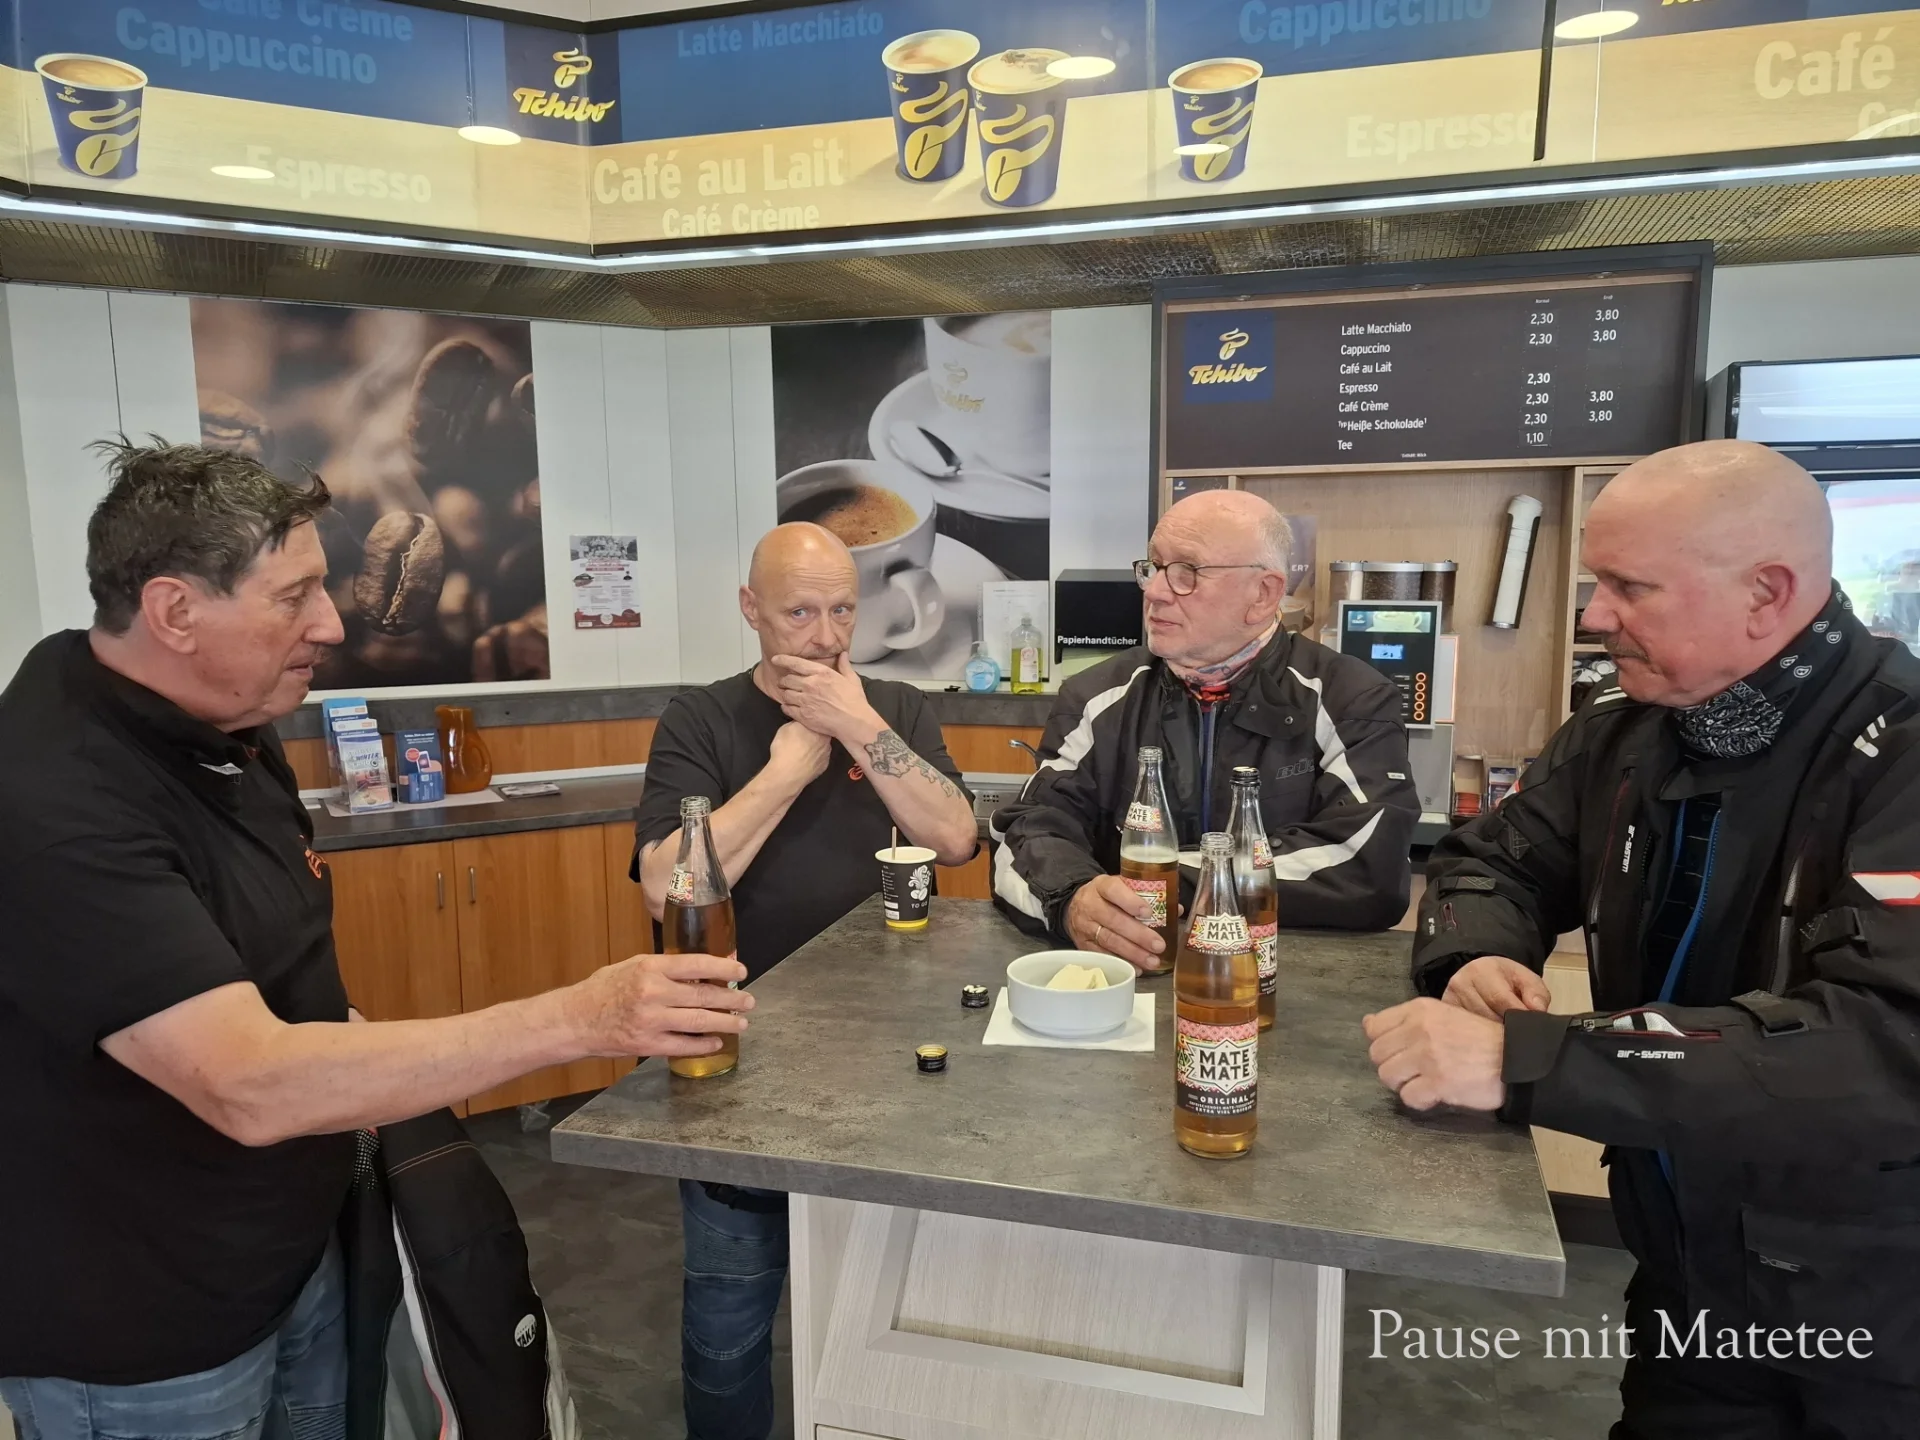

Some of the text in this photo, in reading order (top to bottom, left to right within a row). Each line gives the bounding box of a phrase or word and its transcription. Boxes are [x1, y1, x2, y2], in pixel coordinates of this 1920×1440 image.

[298, 0, 413, 41] Crème
[1239, 0, 1492, 50] Cappuccino
[678, 6, 884, 58] Latte Macchiato
[116, 7, 377, 84] Cappuccino
[1755, 26, 1896, 100] Café
[513, 87, 615, 122] Tchibo
[1346, 110, 1537, 165] Espresso
[244, 146, 431, 202] Espresso
[593, 141, 845, 204] Café au Lait
[662, 203, 820, 238] Café Crème
[1530, 309, 1619, 325] 2,30 3,80
[1341, 322, 1412, 336] Latte Macchiato
[1529, 329, 1617, 346] 2,30 3,80
[1340, 343, 1391, 356] Cappuccino
[1188, 363, 1267, 385] Tchibo
[1340, 361, 1392, 374] Café au Lait
[1527, 372, 1551, 385] 2,30
[1339, 383, 1379, 395] Espresso
[1525, 390, 1614, 405] 2,30 3,80
[1338, 400, 1389, 412] Café Crème
[1524, 410, 1612, 425] 2,30 3,80
[1337, 440, 1353, 450] Tee
[1526, 432, 1544, 444] 1,10
[1057, 635, 1138, 646] Papierhandtücher
[1621, 824, 1636, 873] air-system
[1208, 922, 1241, 931] MATE
[1207, 931, 1243, 940] MATE
[1199, 1049, 1250, 1066] MATE
[1617, 1049, 1685, 1059] air-system
[1199, 1065, 1250, 1080] MATE
[1200, 1095, 1249, 1105] ORIGINAL
